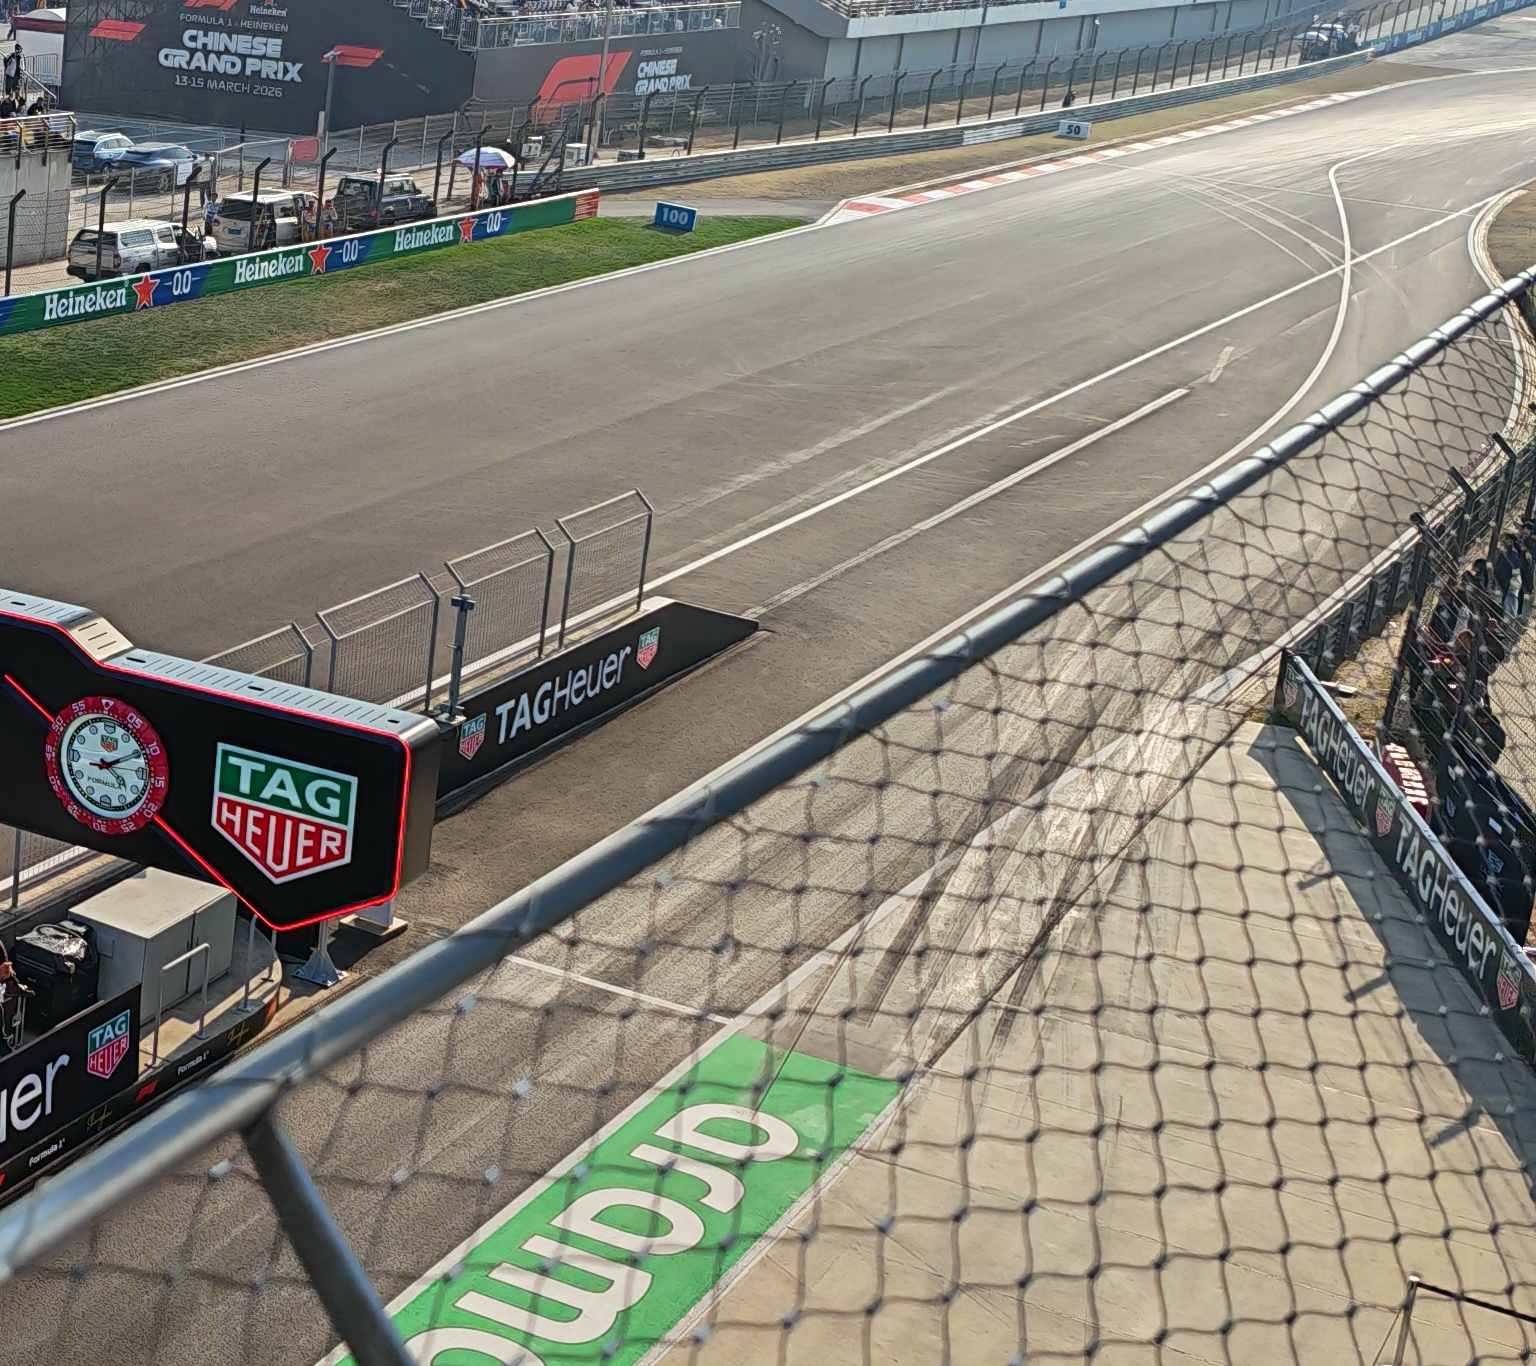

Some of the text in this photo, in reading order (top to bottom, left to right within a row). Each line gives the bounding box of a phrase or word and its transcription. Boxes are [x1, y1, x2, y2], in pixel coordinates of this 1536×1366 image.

[179, 13, 225, 27] FORMULA
[240, 19, 289, 32] HEINEKEN
[182, 29, 283, 59] CHINESE
[158, 47, 304, 83] GRAND PRIX
[174, 75, 283, 98] 13-15 MARCH 2026
[1066, 124, 1081, 136] 50
[662, 207, 689, 226] 100
[394, 221, 457, 253] Heineken
[234, 249, 305, 284] Heineken
[42, 284, 128, 321] Heineken
[126, 712, 144, 729] 05
[464, 716, 485, 737] TAG
[147, 741, 161, 756] 10
[154, 776, 165, 788] 15
[227, 755, 343, 819] TAG
[143, 803, 158, 818] 20
[120, 821, 137, 833] 25
[220, 804, 342, 874] HEUER
[91, 1011, 128, 1049] TAG
[88, 1037, 129, 1077] HEUER
